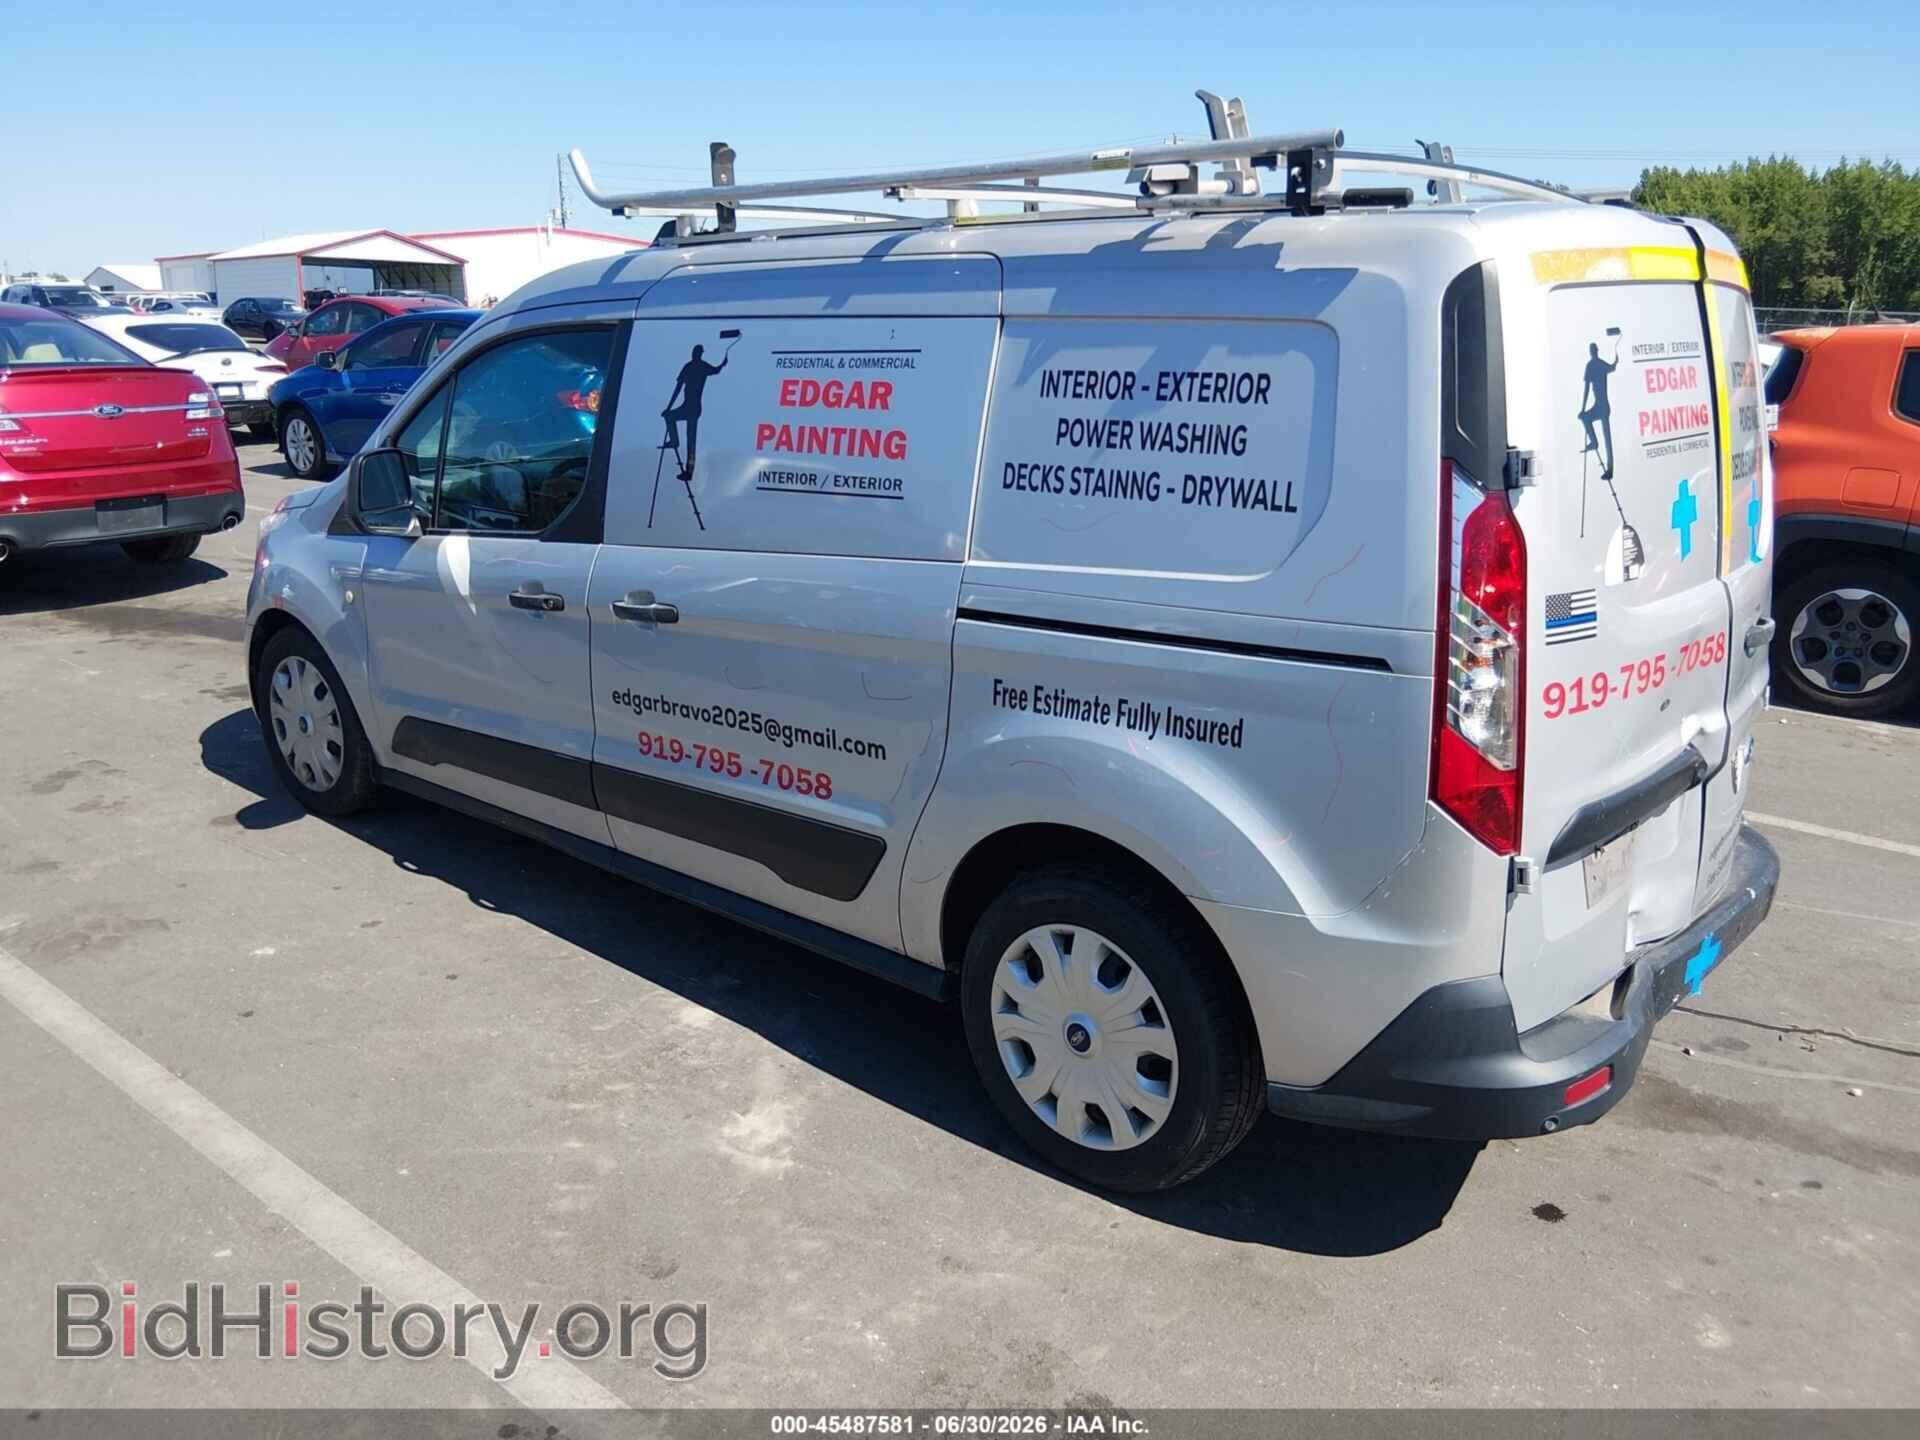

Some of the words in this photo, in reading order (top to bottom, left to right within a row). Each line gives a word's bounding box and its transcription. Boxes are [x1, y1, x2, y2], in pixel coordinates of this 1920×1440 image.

[776, 357, 835, 369] RESIDENTIAL
[838, 357, 846, 369] &
[848, 357, 917, 369] COMMERCIAL
[1631, 343, 1665, 355] INTERIOR
[1671, 341, 1700, 353] EXTERIOR
[779, 379, 894, 410] EDGAR
[1040, 369, 1137, 400] INTERIOR
[1155, 371, 1272, 404] EXTERIOR
[1644, 365, 1697, 394] EDGAR
[1638, 403, 1709, 436] PAINTING
[755, 423, 907, 460] PAINTING
[1056, 418, 1134, 450] POWER
[1139, 421, 1248, 456] WASHING
[758, 471, 818, 487] INTERIOR
[820, 474, 829, 490] /
[833, 474, 903, 492] EXTERIOR
[1003, 462, 1065, 494] DECKS
[1069, 466, 1161, 502] STAINNG
[1181, 474, 1298, 513] DRYWALL
[612, 688, 887, 760] edgarbravo2025@gmail.com
[993, 679, 1028, 712] Free
[1033, 685, 1111, 725] Estimate
[1115, 698, 1161, 740] Fully
[1165, 706, 1244, 749] Insured
